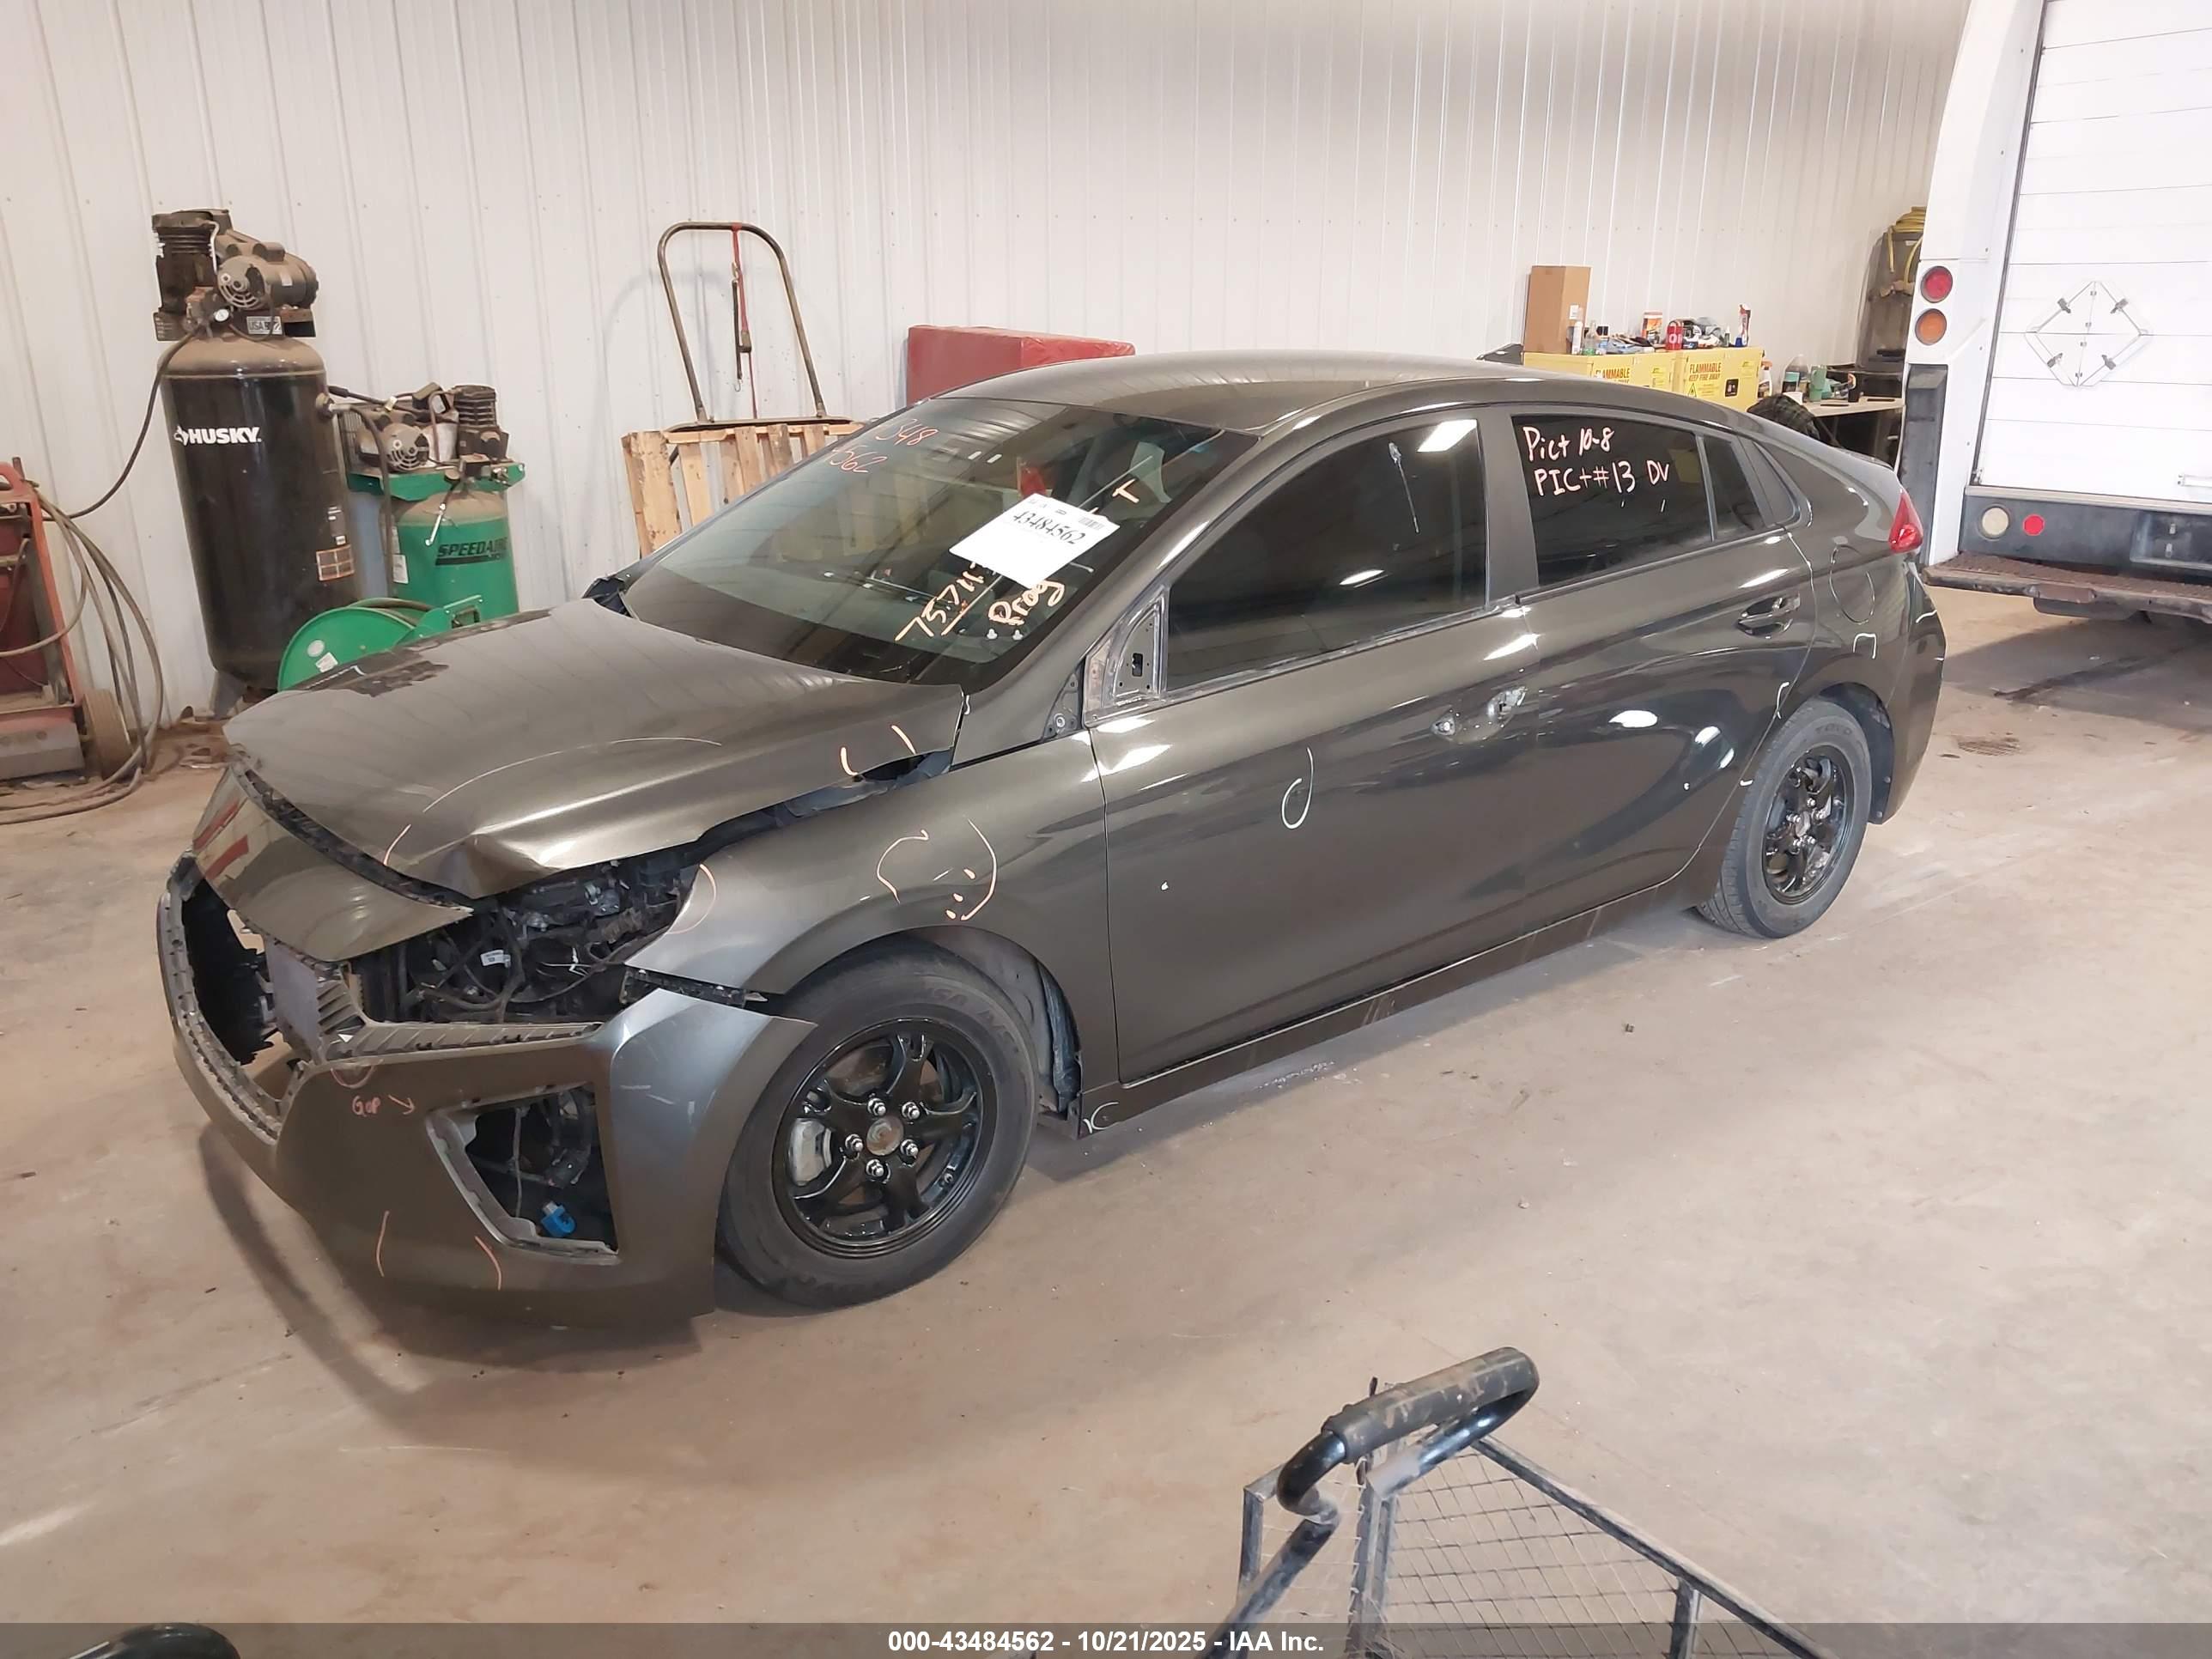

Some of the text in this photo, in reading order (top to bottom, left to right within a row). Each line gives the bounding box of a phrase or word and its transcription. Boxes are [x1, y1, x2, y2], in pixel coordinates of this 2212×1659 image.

[1689, 362, 1722, 374] FLAMMABLE
[187, 427, 260, 445] HUSKY
[1013, 510, 1086, 545] 43484562
